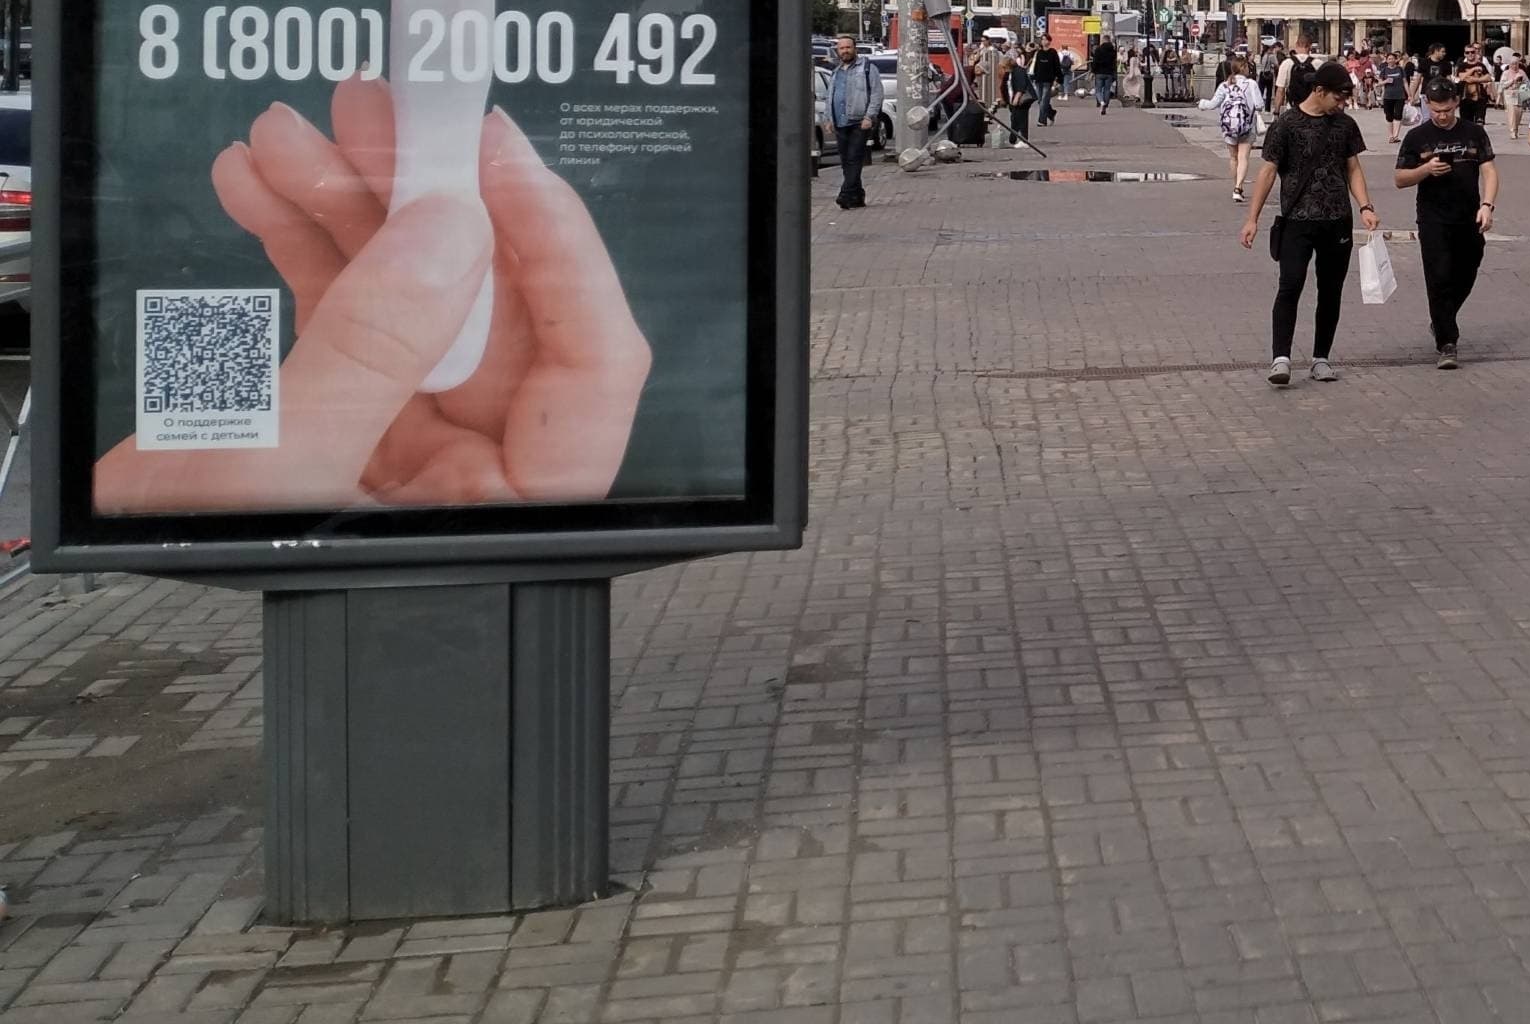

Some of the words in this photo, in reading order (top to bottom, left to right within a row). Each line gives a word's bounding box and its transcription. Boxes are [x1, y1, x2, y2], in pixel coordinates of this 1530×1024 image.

[139, 4, 180, 80] 8
[203, 5, 383, 81] (800)
[408, 8, 575, 84] 2000
[593, 12, 718, 85] 492
[560, 103, 570, 112] О
[573, 104, 600, 113] всех
[604, 104, 642, 114] мерах
[645, 104, 719, 115] поддержки,
[560, 117, 573, 126] от
[576, 116, 663, 127] юридической
[559, 130, 575, 140] до
[560, 143, 575, 152] по
[578, 142, 638, 153] телефону
[641, 142, 692, 153] горячей
[560, 156, 600, 165] линии
[164, 418, 174, 427] О
[178, 418, 252, 428] поддержке
[156, 430, 197, 441] семей
[201, 432, 207, 440] с
[211, 431, 259, 441] детьми
